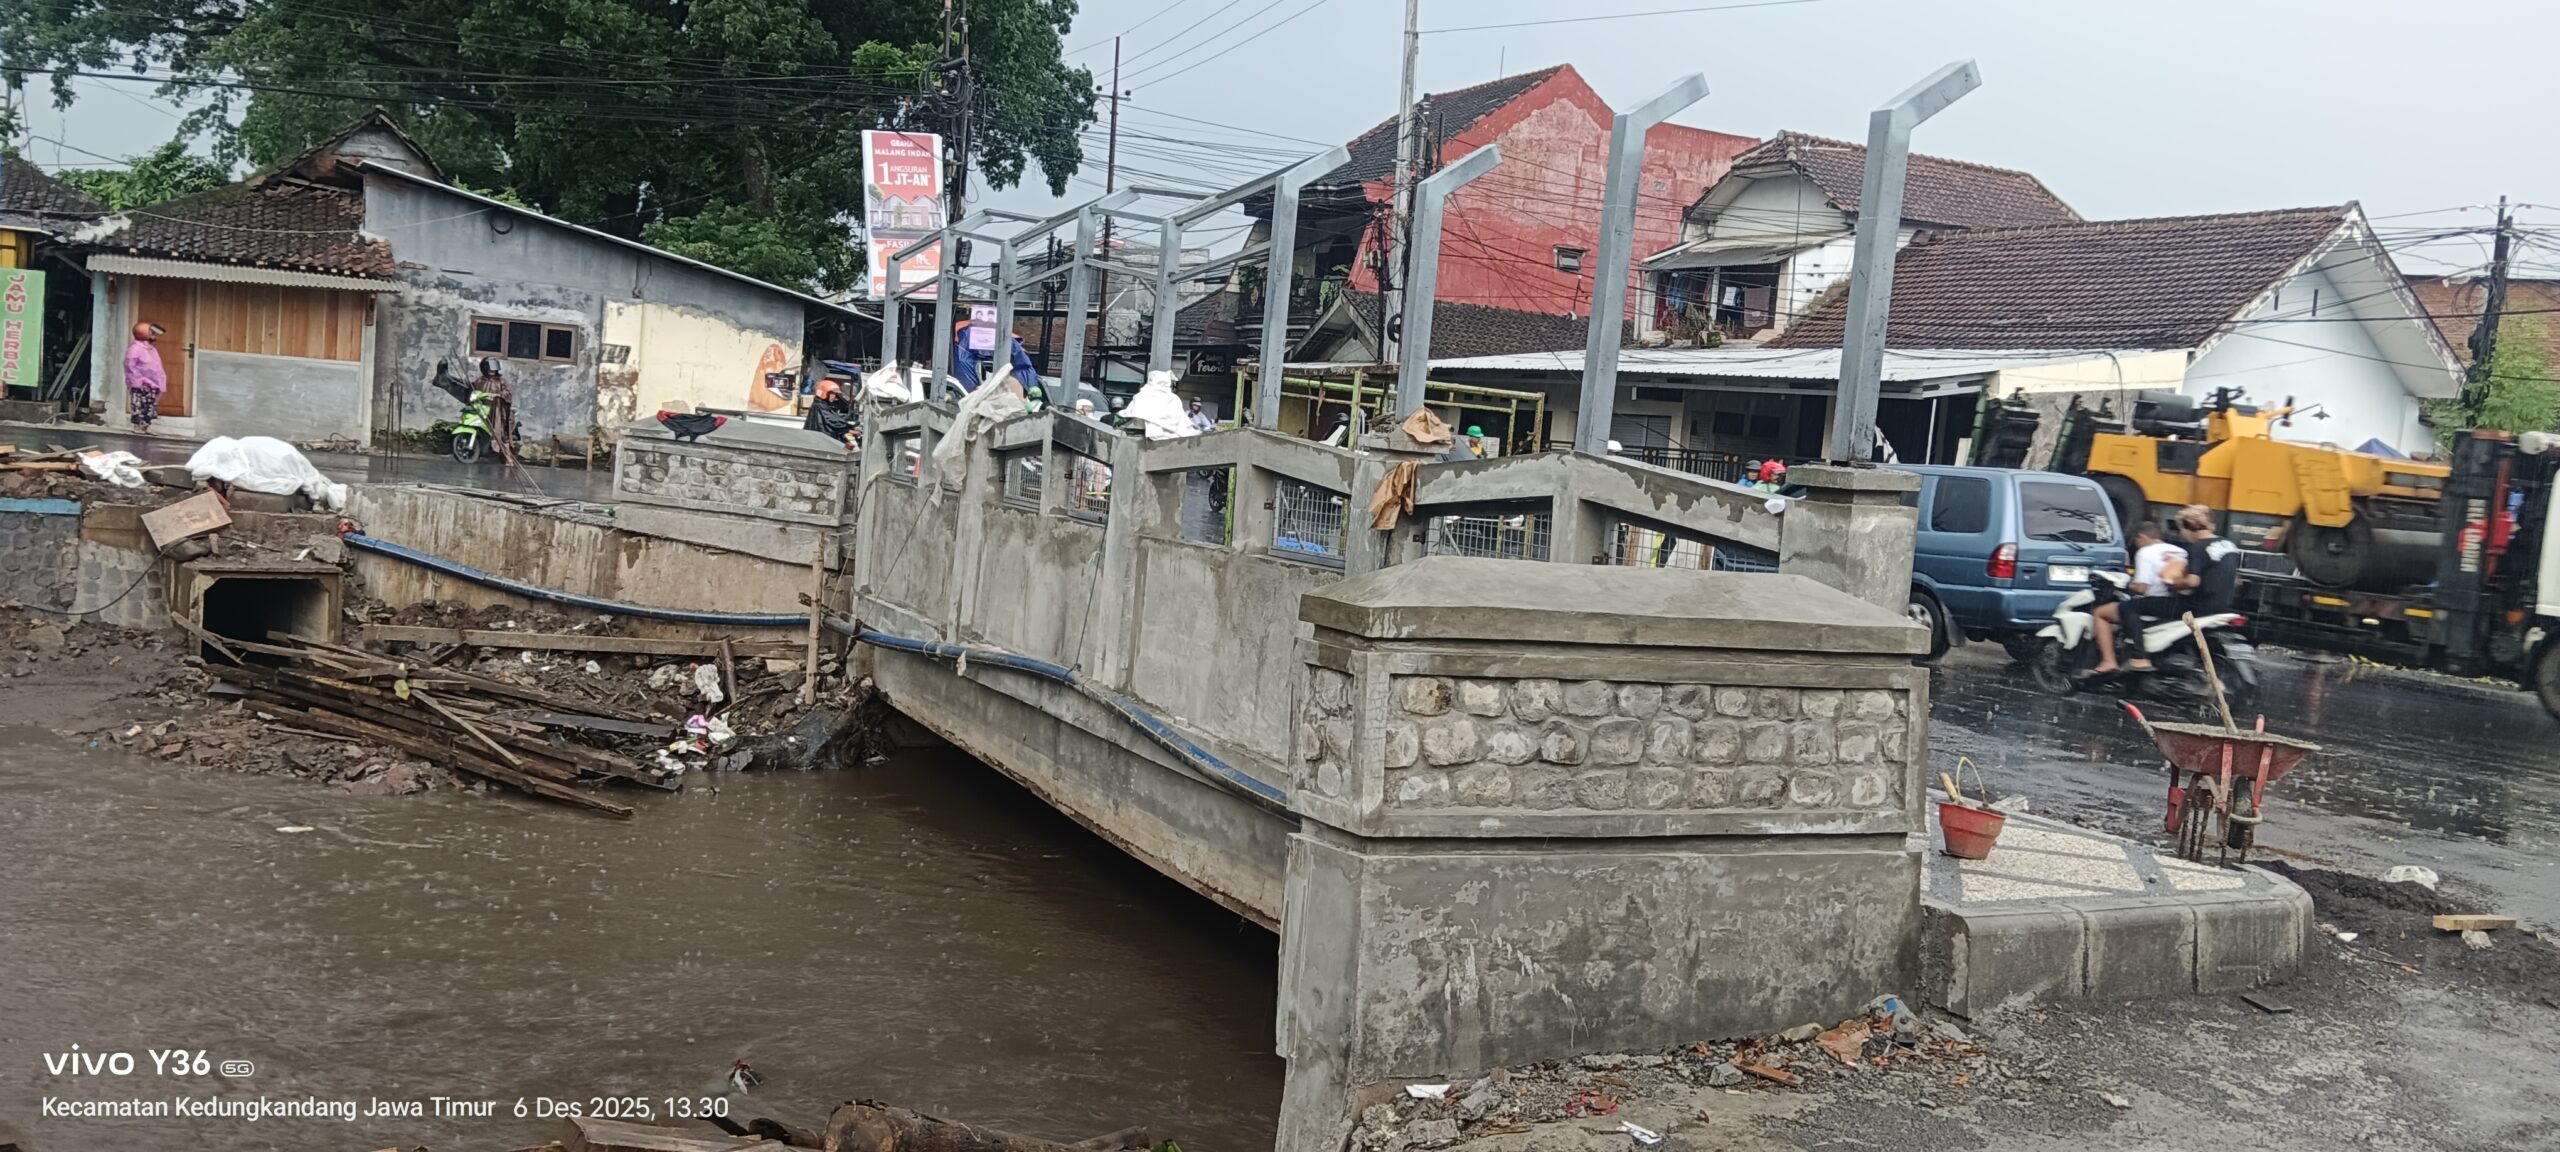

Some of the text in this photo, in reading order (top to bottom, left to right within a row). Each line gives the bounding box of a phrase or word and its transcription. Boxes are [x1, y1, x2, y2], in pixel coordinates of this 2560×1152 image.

[874, 148, 906, 157] MALANG
[878, 161, 893, 185] 1
[889, 165, 928, 174] ANGSURAN
[3, 274, 27, 380] JAMU HERBAL
